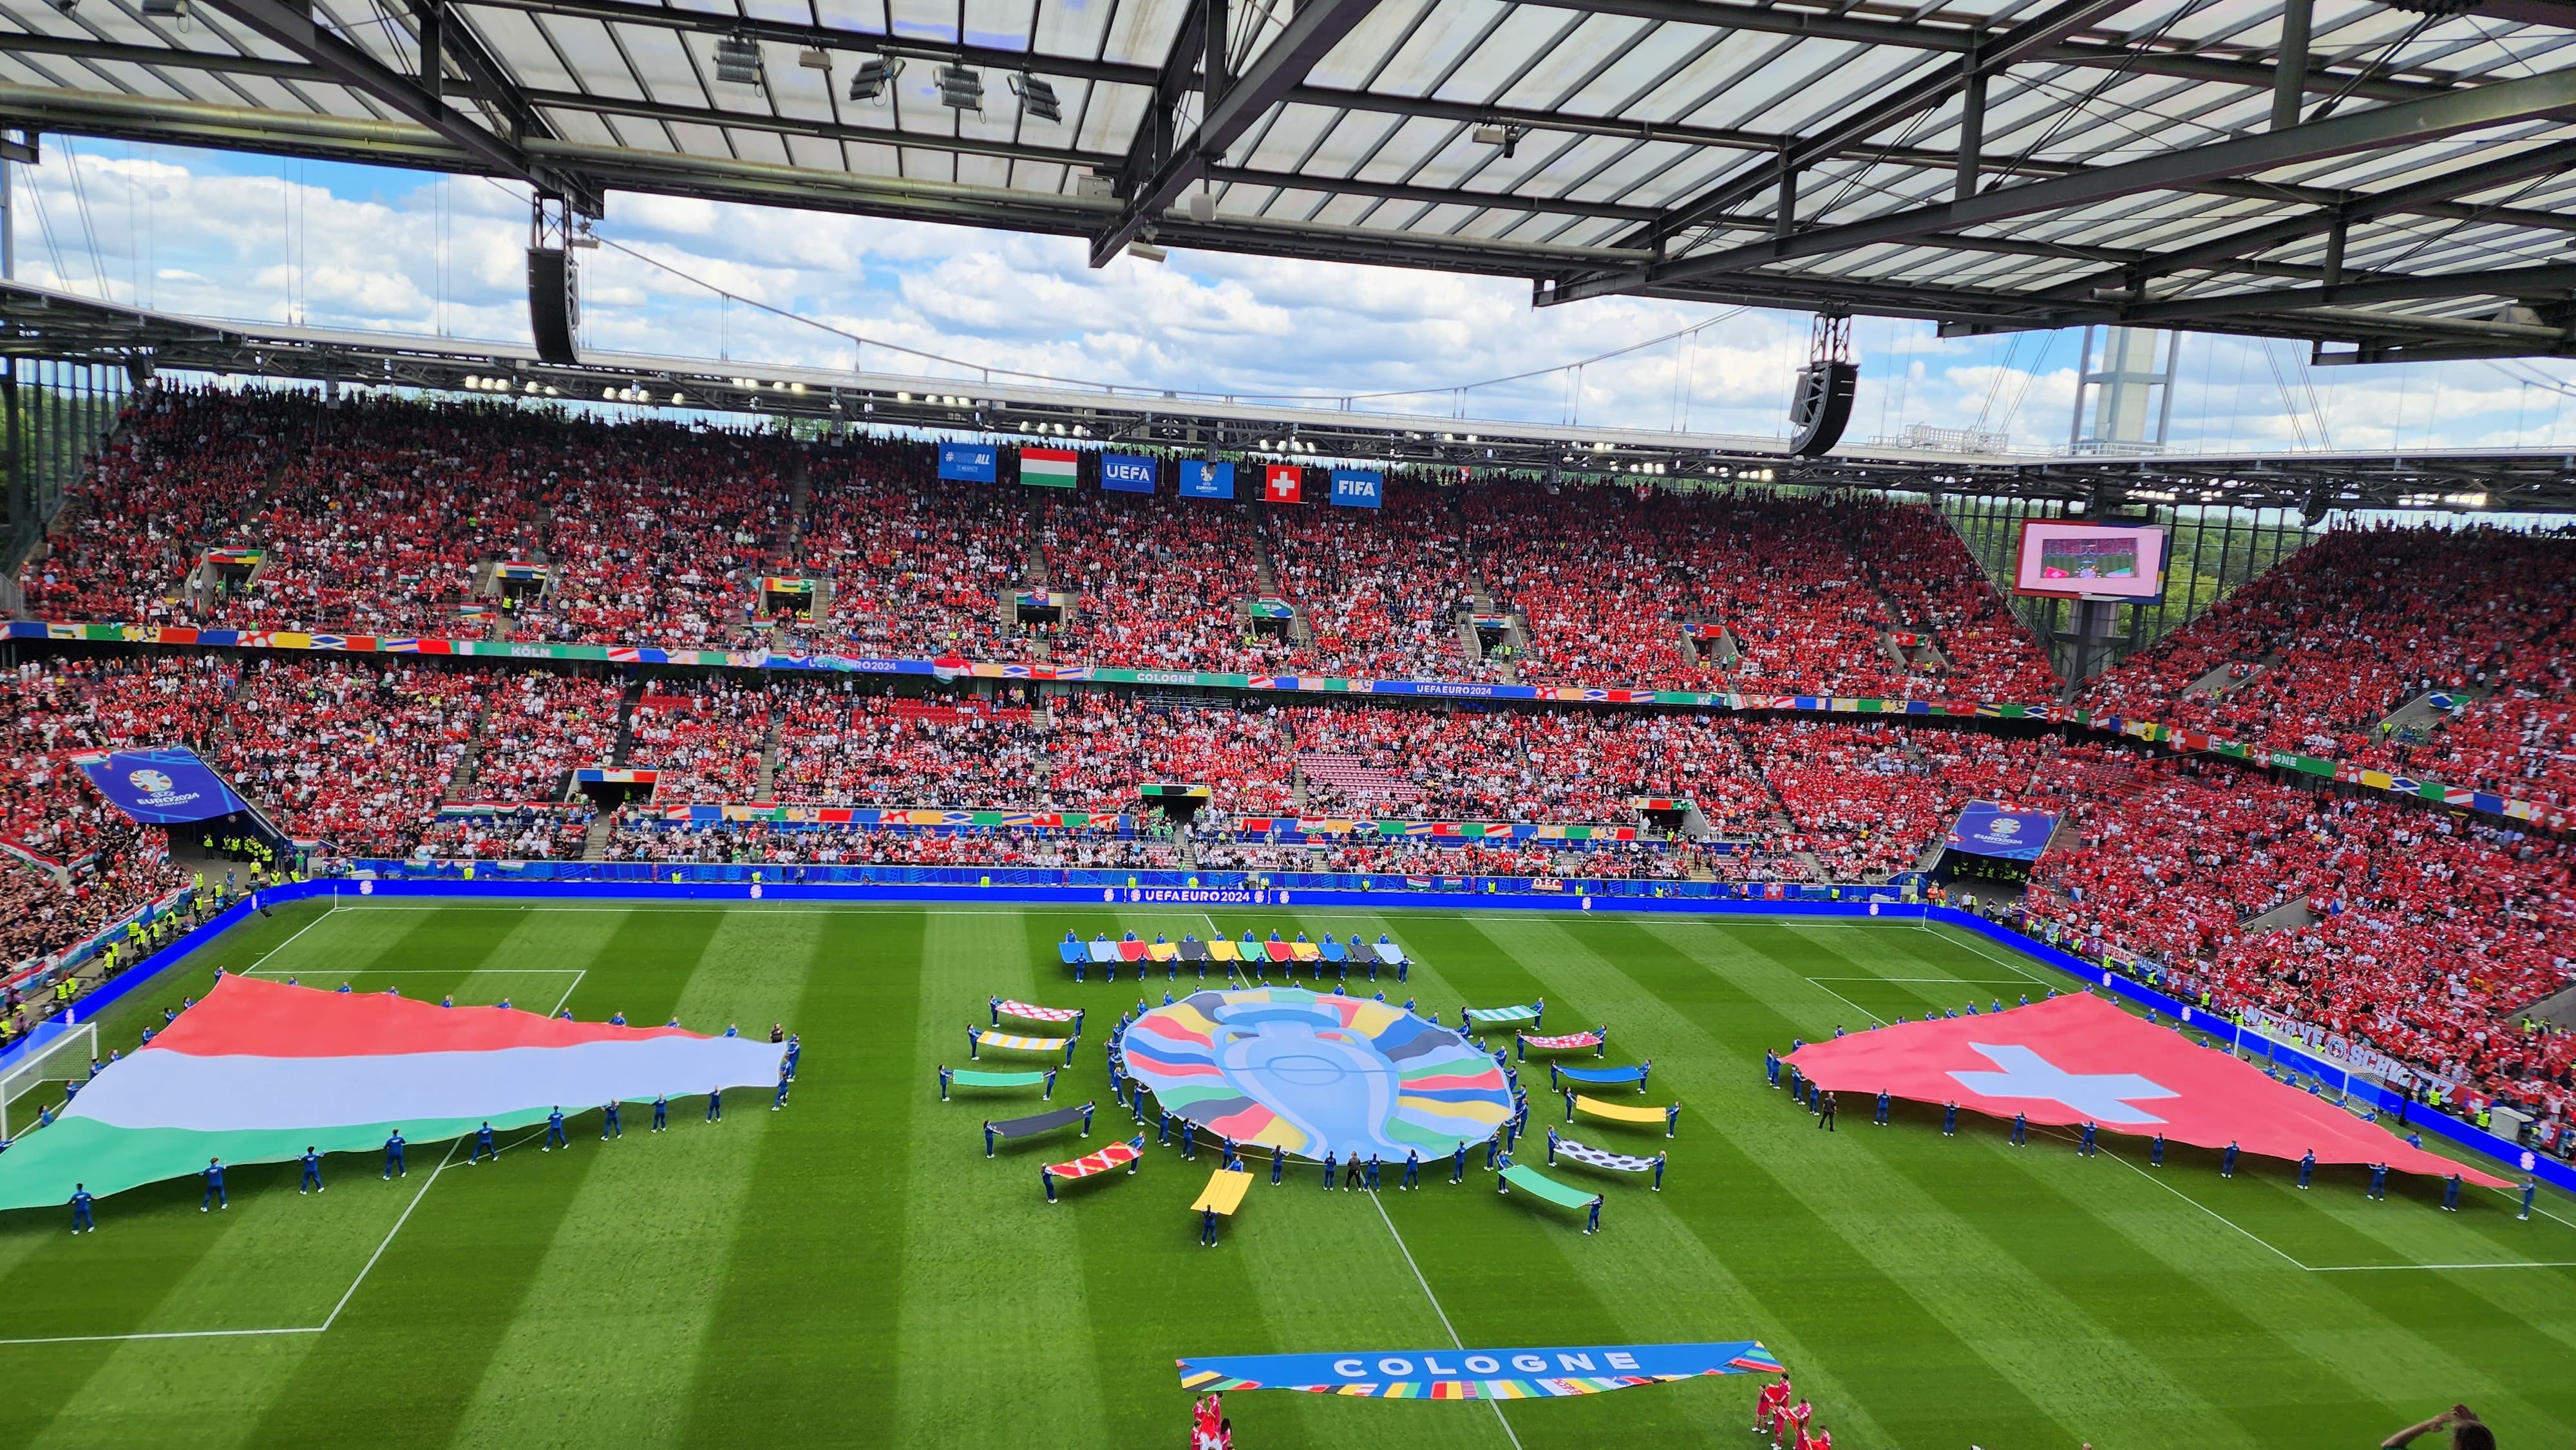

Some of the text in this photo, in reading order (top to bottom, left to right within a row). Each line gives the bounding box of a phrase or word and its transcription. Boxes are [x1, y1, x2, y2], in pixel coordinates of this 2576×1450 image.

[1106, 464, 1150, 482] UEFA
[1339, 480, 1375, 496] FIFA
[511, 645, 551, 657] KÖLN
[1137, 673, 1195, 683] COLOGNE
[136, 792, 200, 805] EURO2024
[1973, 833, 2023, 845] EURO2024
[1333, 1352, 1640, 1377] COLOGNE
